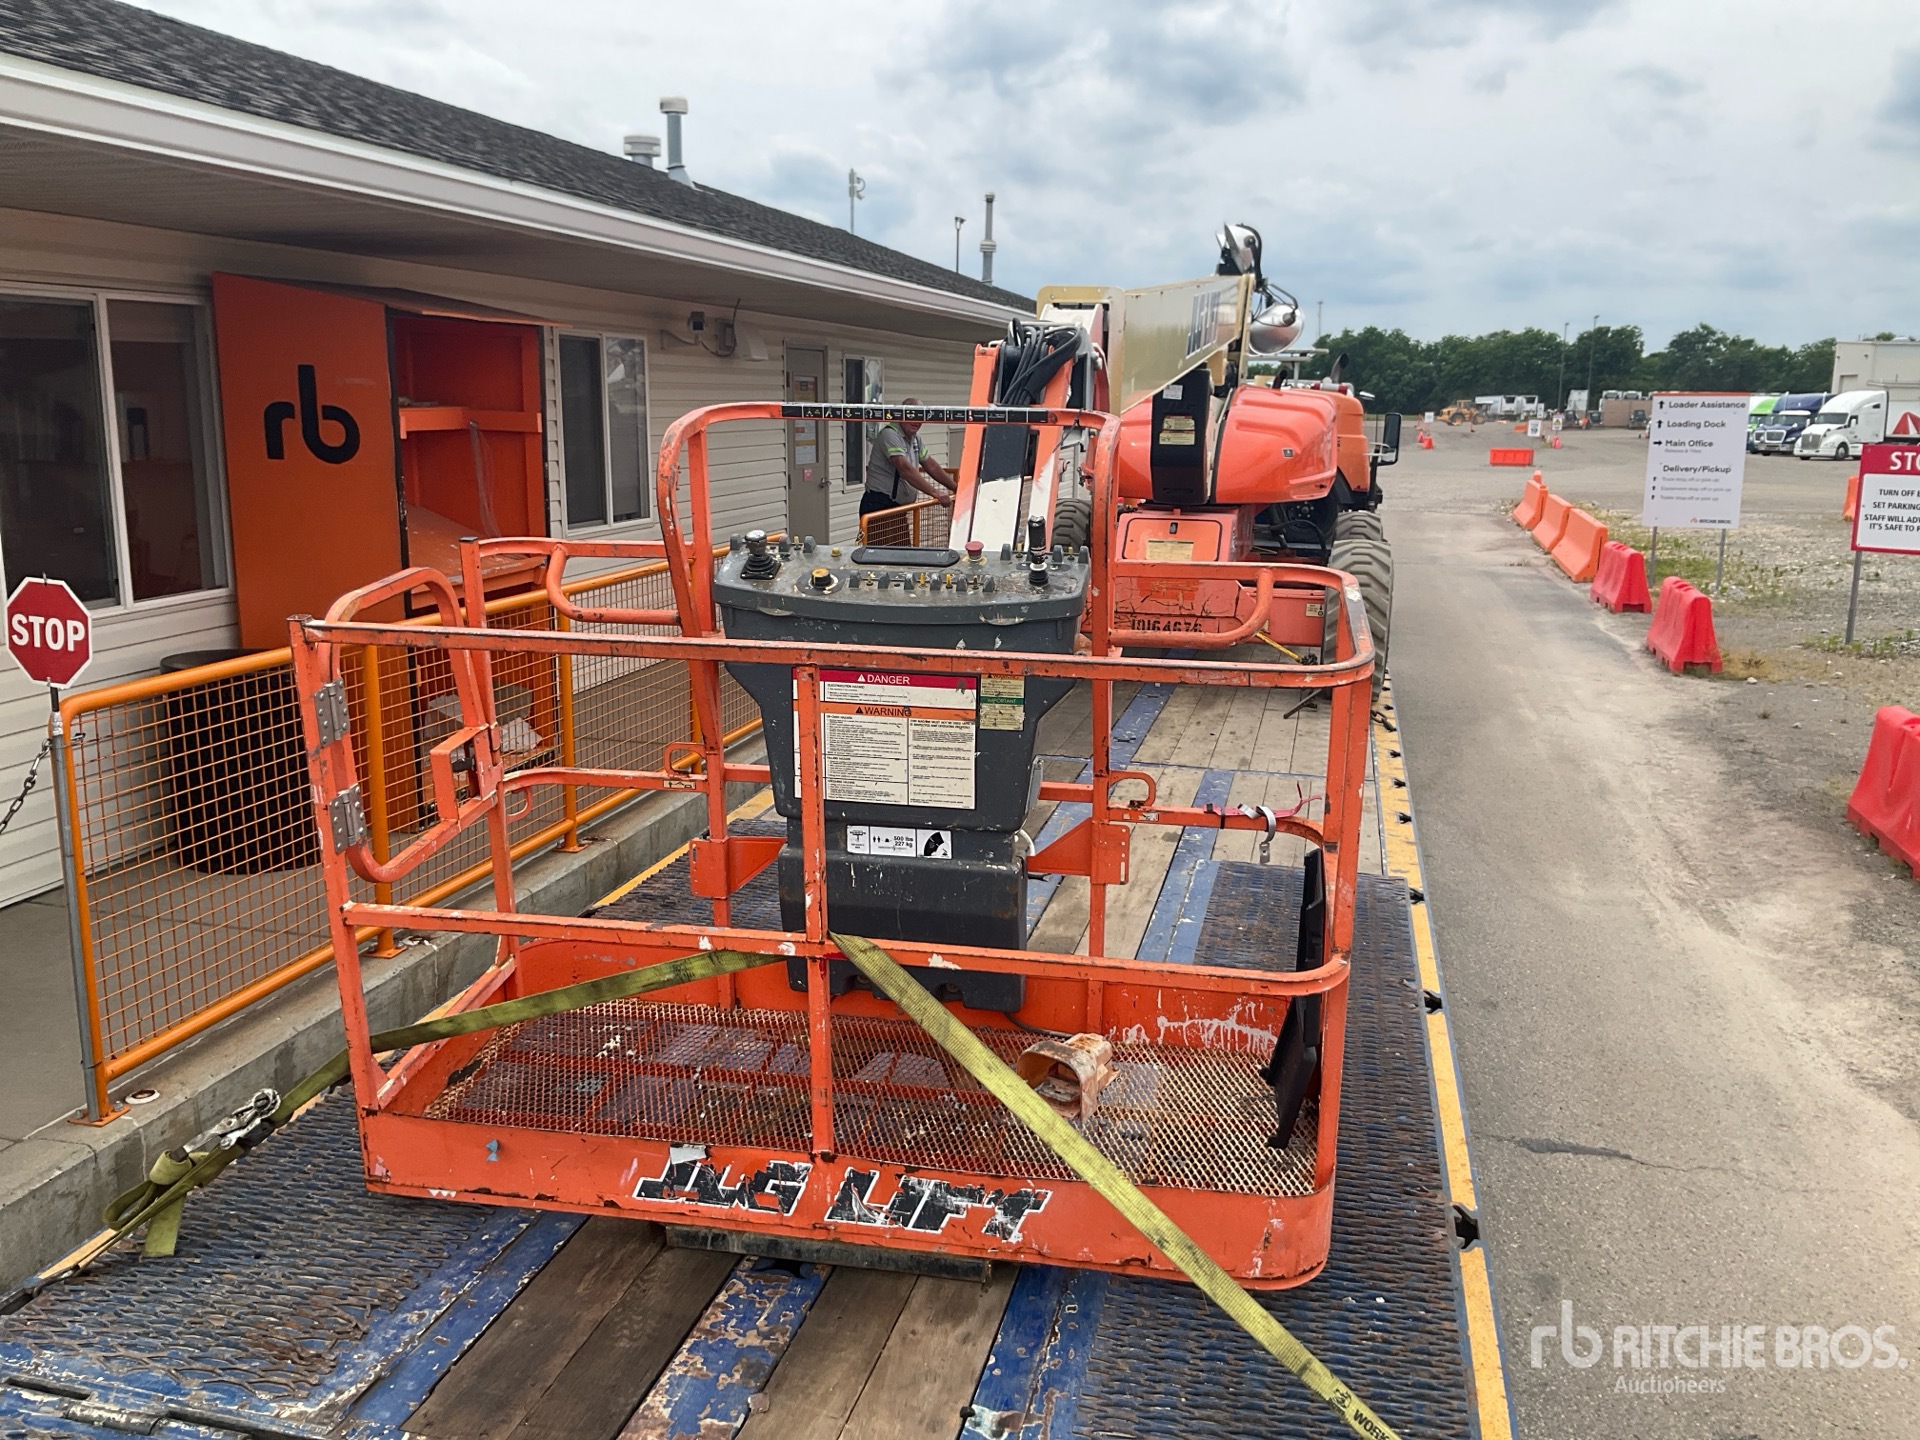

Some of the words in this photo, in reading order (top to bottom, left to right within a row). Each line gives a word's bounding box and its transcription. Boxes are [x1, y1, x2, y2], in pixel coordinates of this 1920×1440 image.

[1668, 401, 1698, 409] Loader
[1700, 401, 1747, 409] Assistance
[264, 364, 361, 464] rb
[1667, 420, 1702, 429] Loading
[1703, 420, 1727, 428] Dock
[1663, 464, 1732, 474] Delivery/Pickup
[1872, 501, 1886, 509] SET
[1887, 515, 1905, 523] WILL
[1905, 524, 1915, 532] TO
[11, 613, 86, 652] STOP
[867, 674, 911, 685] DANGER
[864, 706, 912, 717] WARNING
